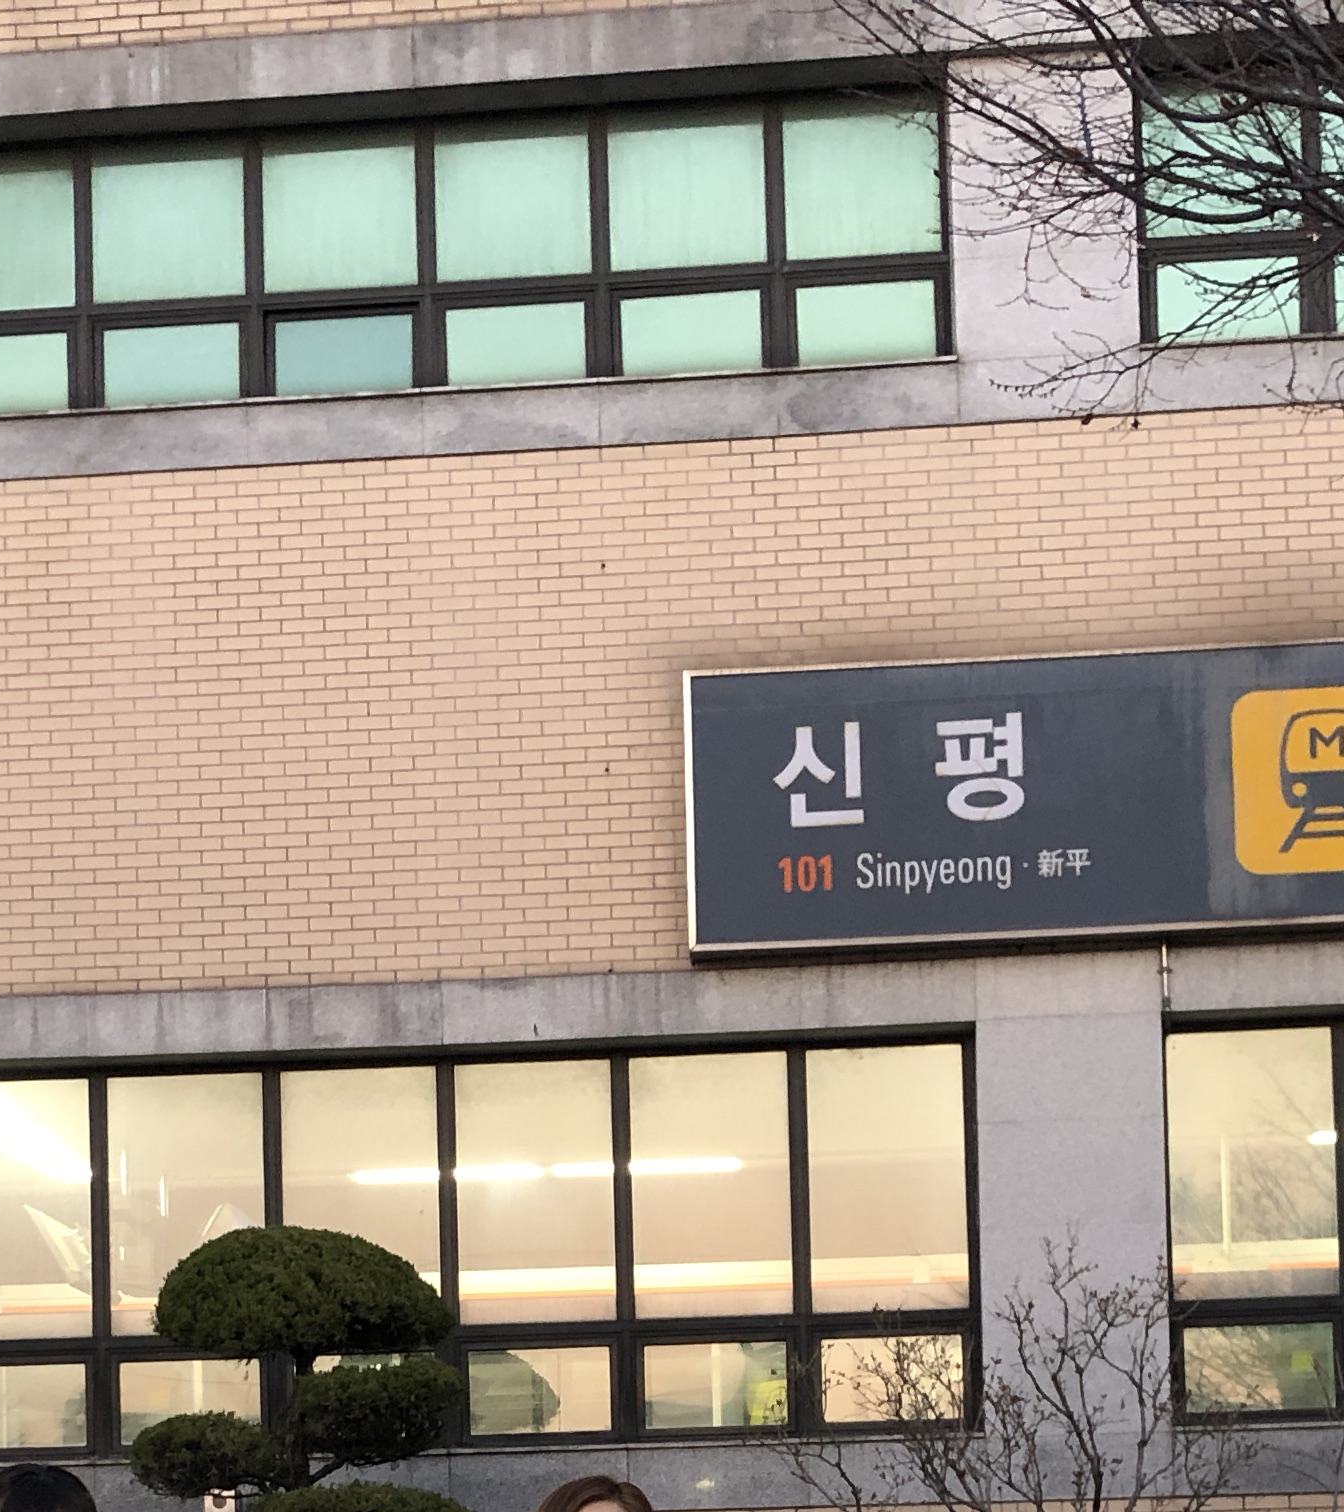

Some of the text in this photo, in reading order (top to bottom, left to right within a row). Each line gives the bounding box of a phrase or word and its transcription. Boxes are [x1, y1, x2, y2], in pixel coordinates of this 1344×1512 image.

[777, 848, 1092, 895] 101 Sinpyeong 新平
